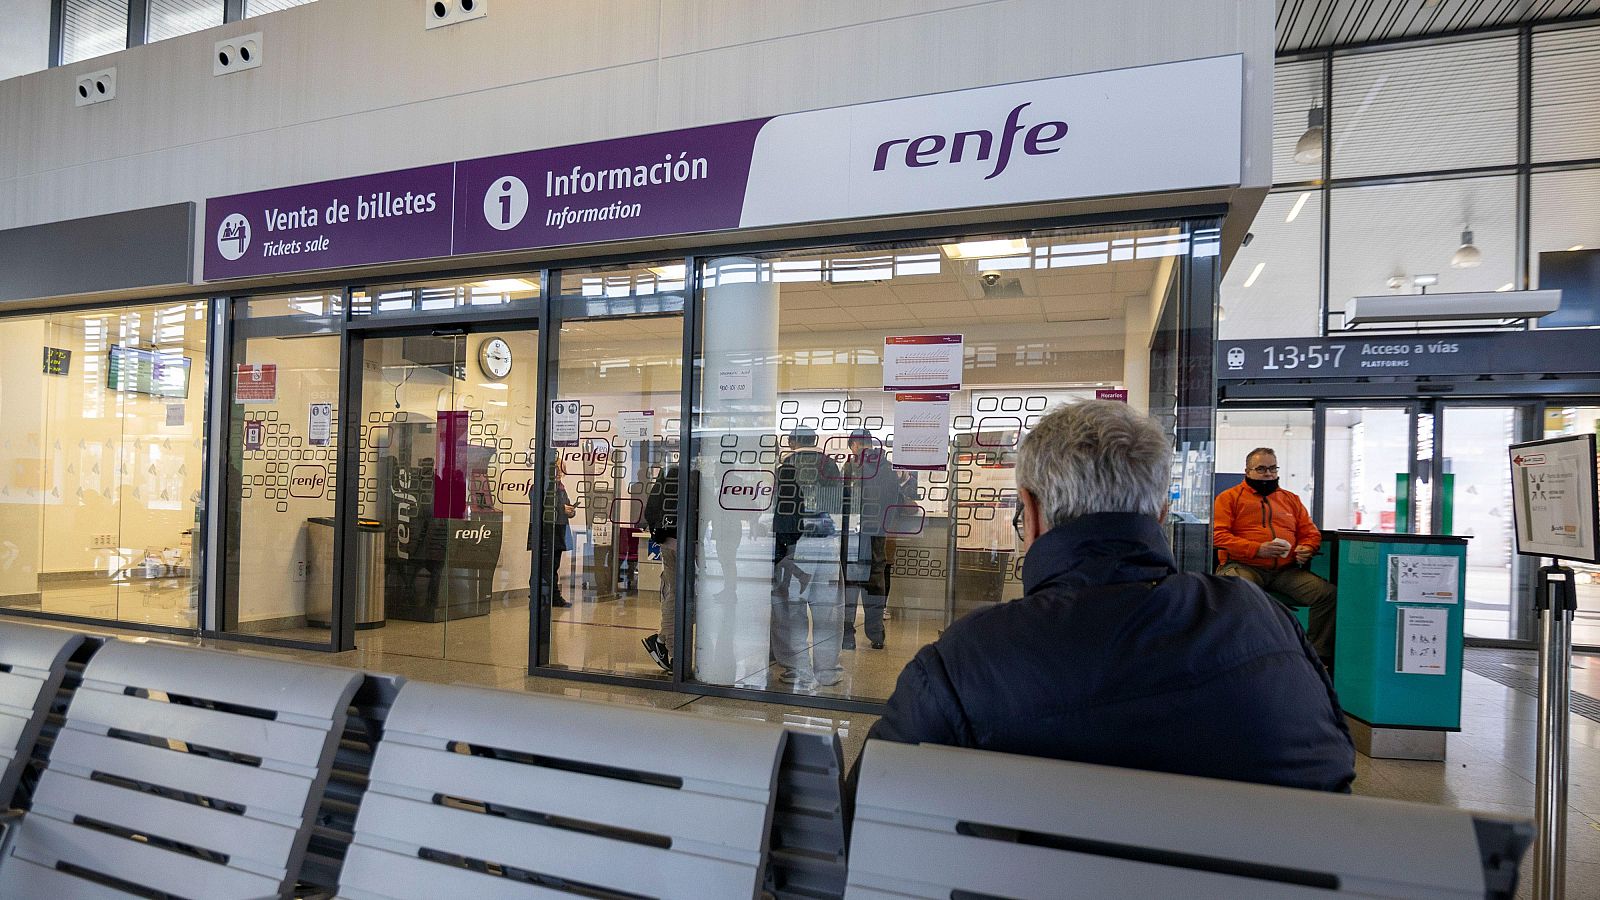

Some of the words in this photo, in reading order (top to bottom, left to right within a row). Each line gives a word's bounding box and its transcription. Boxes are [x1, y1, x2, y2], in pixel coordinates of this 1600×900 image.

[873, 102, 1068, 180] renfe
[546, 152, 709, 198] Información
[264, 205, 319, 232] Venta
[325, 198, 350, 225] de
[357, 189, 437, 221] billetes
[545, 201, 641, 228] Information
[263, 239, 301, 258] Tickets
[304, 235, 330, 254] sale
[1361, 342, 1410, 356] Acceso
[1414, 345, 1423, 354] a
[1427, 341, 1459, 354] vías
[1361, 360, 1410, 368] PLATFORMS
[565, 448, 606, 466] renfe
[827, 447, 878, 468] renfe
[292, 474, 324, 490] renfe
[501, 478, 533, 496] renf
[722, 480, 773, 501] renfe
[391, 468, 418, 560] renfe
[455, 524, 492, 545] renfe
